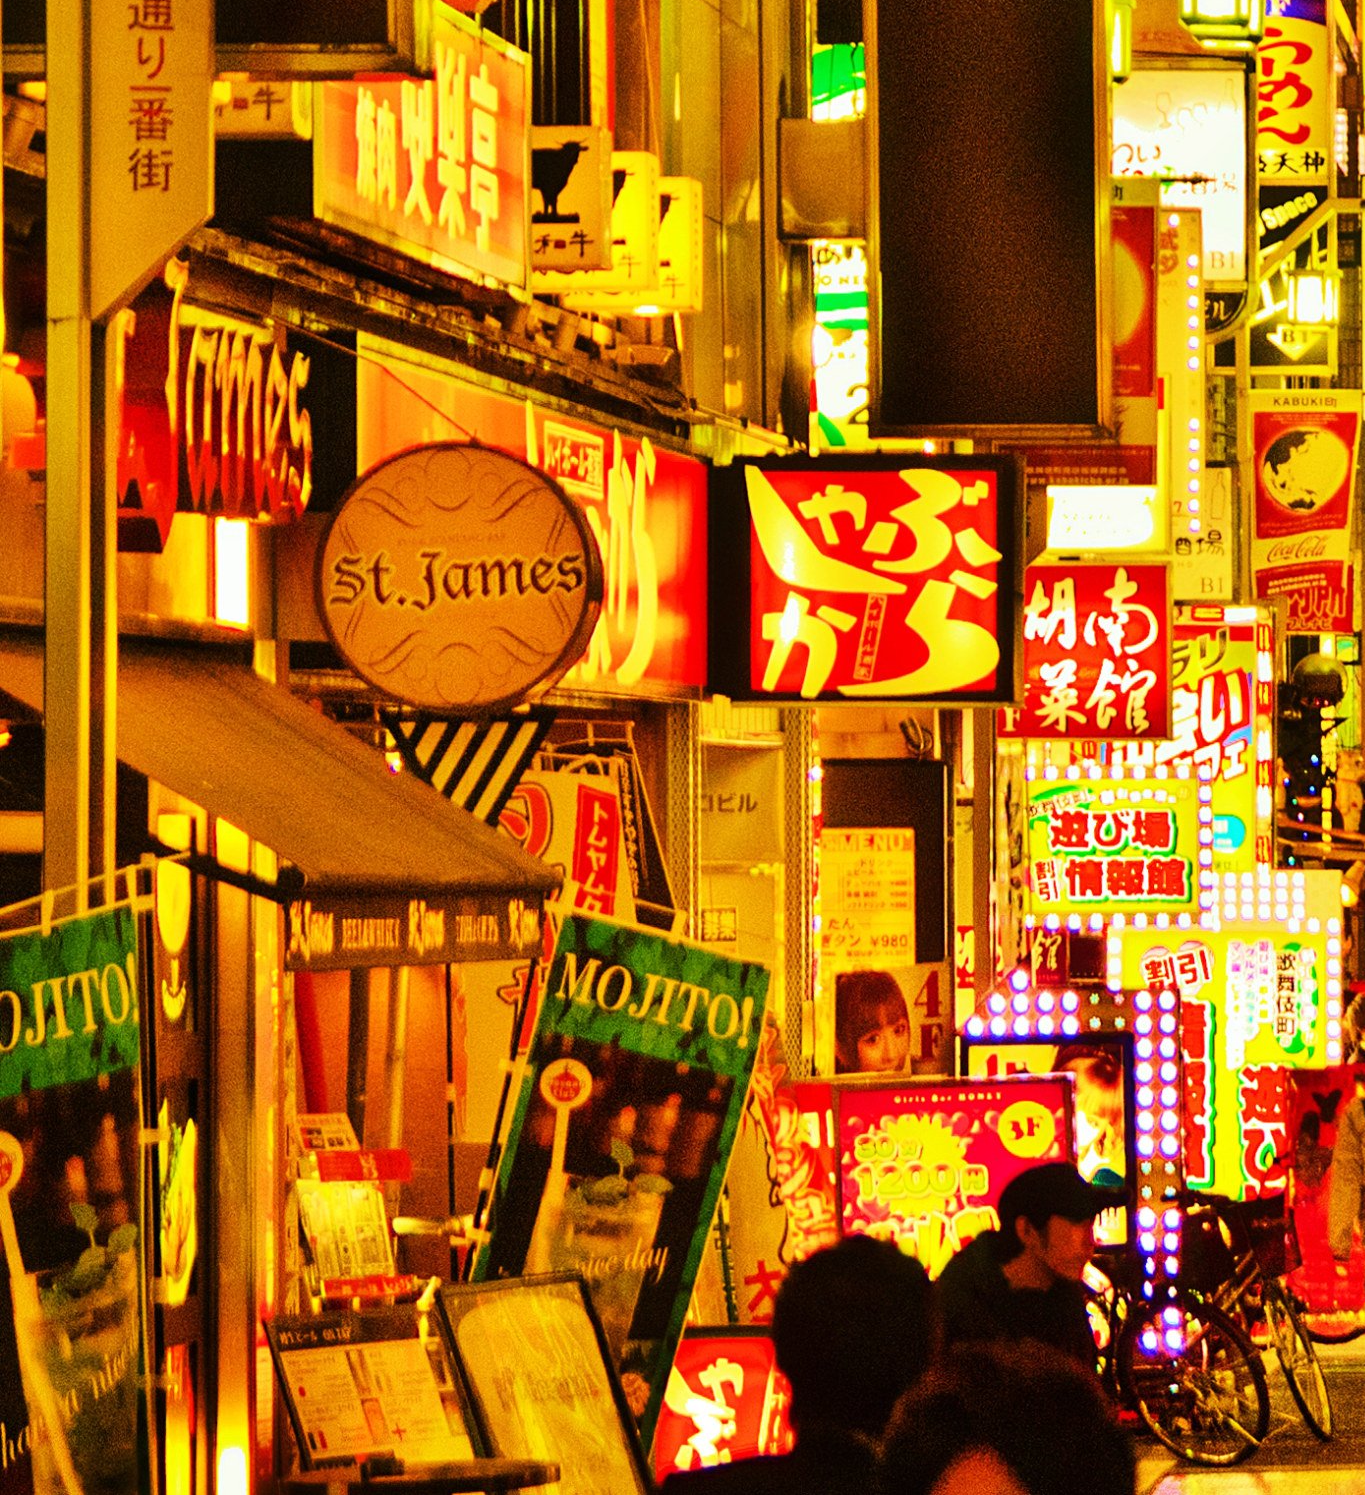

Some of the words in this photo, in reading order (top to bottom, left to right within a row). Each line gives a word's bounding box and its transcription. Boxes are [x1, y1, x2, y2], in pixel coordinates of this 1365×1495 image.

[1049, 809, 1176, 855] 遊び場
[870, 935, 908, 947] ¥980
[556, 952, 756, 1048] MOJITO!
